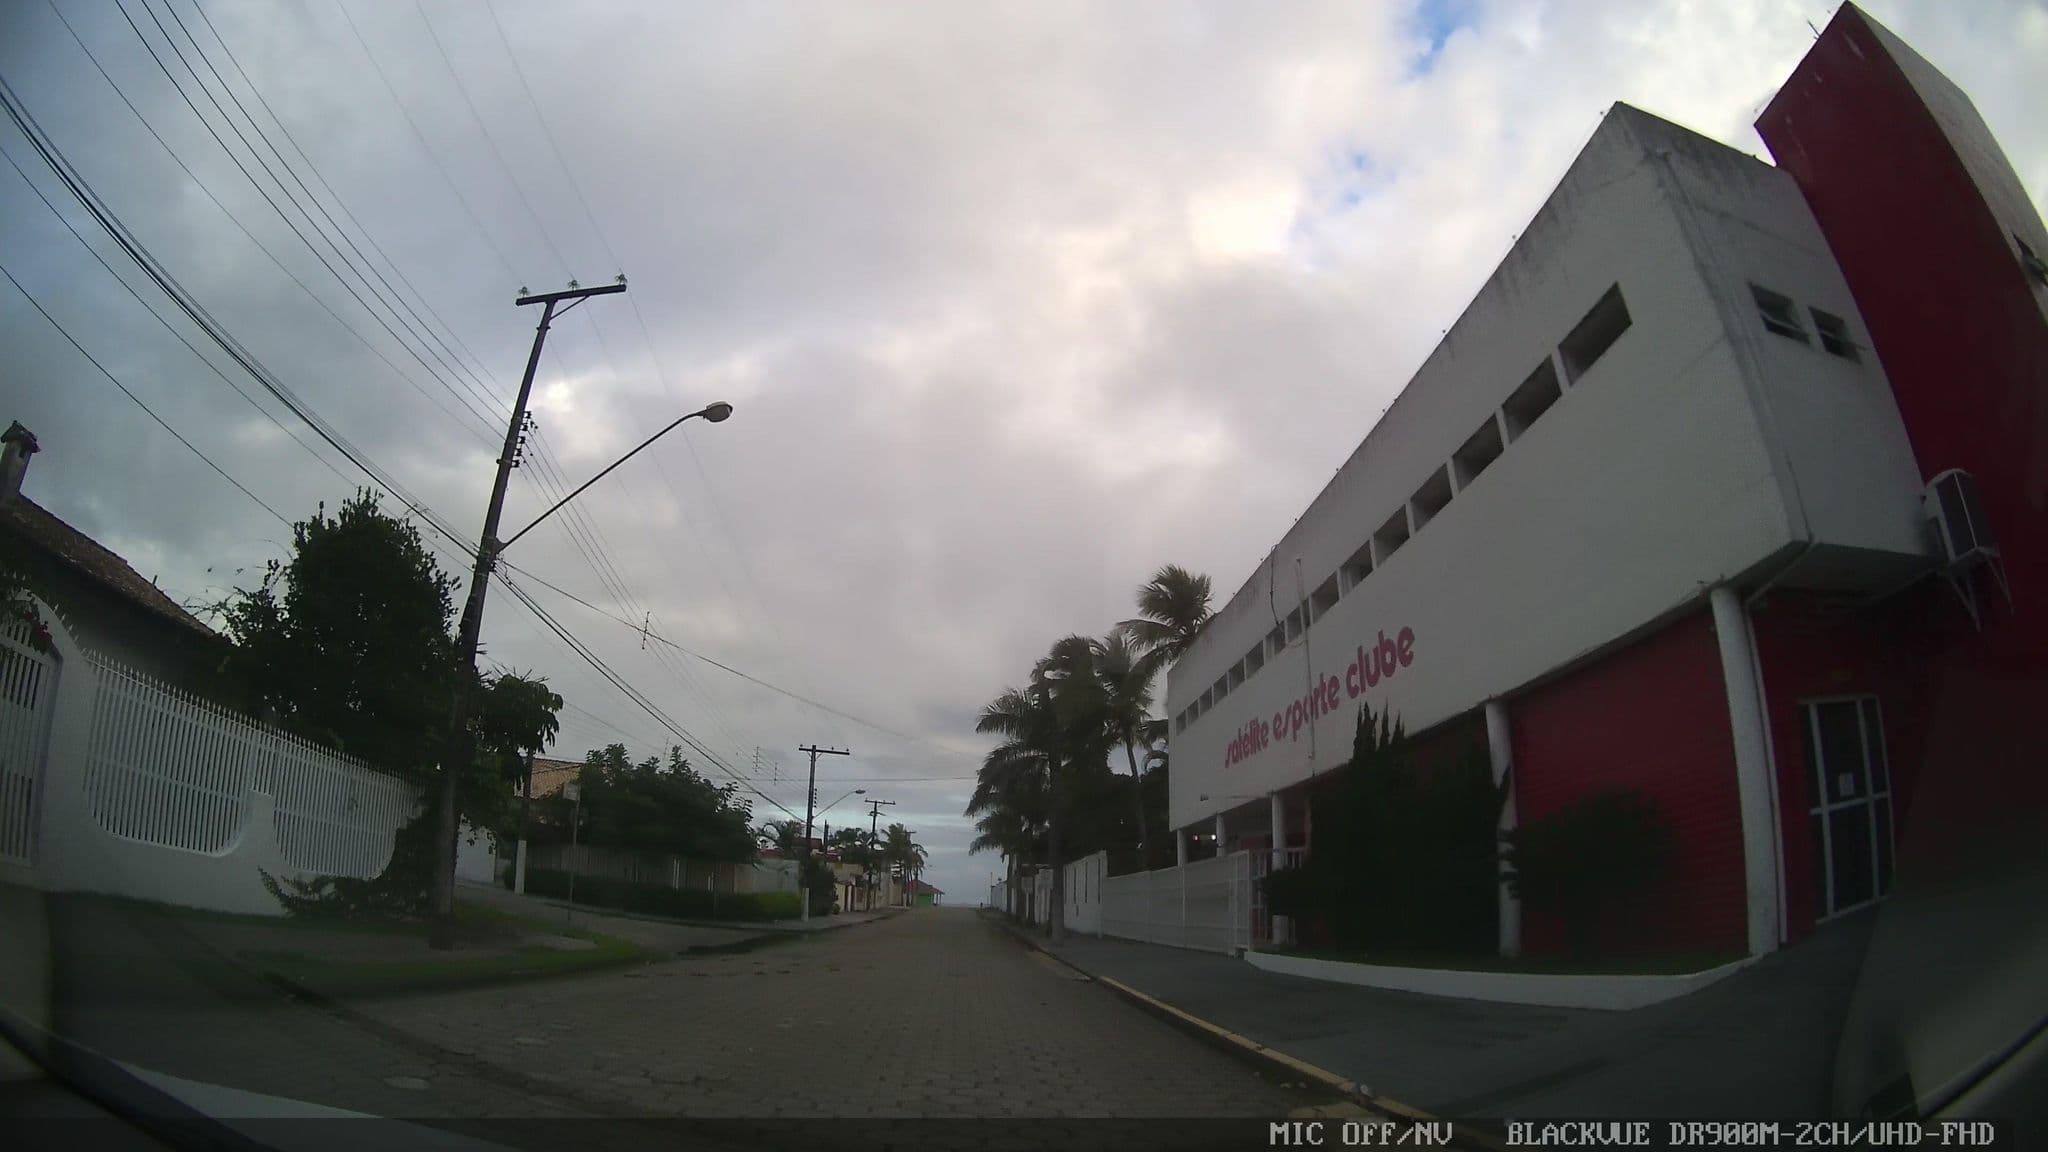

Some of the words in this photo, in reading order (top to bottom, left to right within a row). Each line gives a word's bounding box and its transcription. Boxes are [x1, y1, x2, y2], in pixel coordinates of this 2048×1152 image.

[1225, 717, 1269, 768] satélite
[1272, 673, 1340, 741] esporte
[1346, 626, 1415, 699] clube
